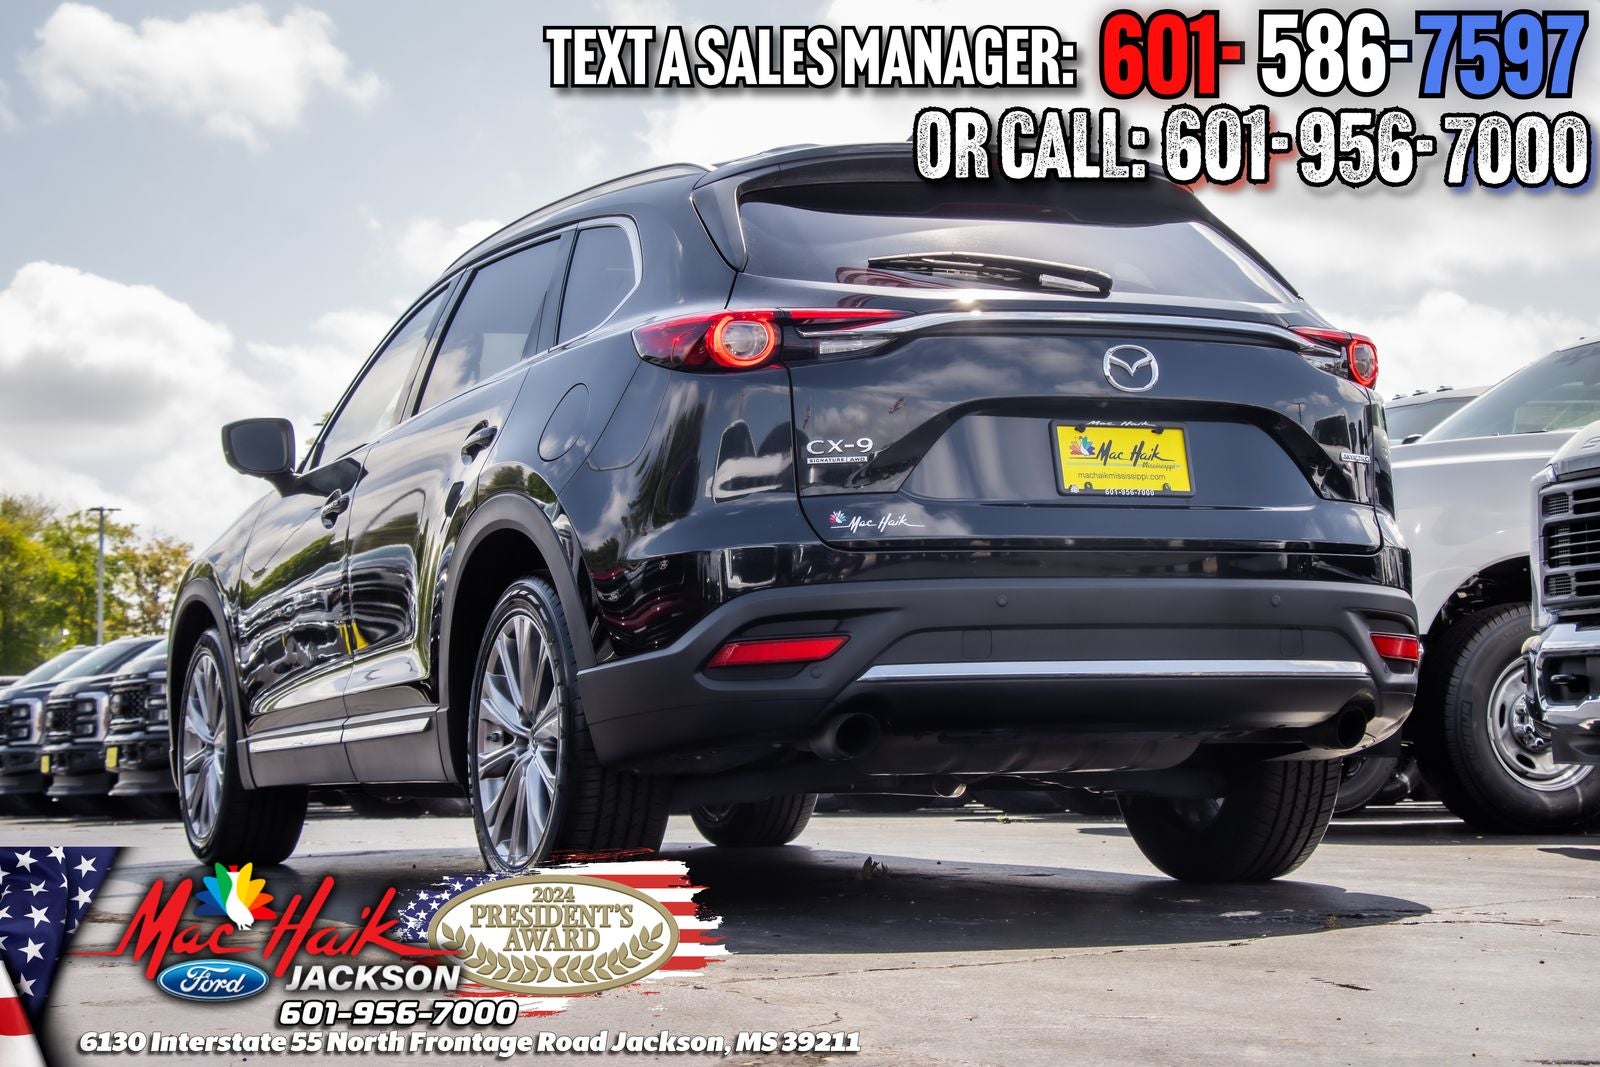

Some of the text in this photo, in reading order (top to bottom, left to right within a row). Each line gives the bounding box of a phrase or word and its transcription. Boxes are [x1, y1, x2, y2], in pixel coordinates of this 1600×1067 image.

[806, 437, 873, 455] CX-9
[1088, 439, 1175, 467] Mac Haik
[1142, 462, 1175, 471] Mississippi
[1078, 471, 1166, 481] machaikmississippi.com
[839, 513, 925, 533] Mac Haik
